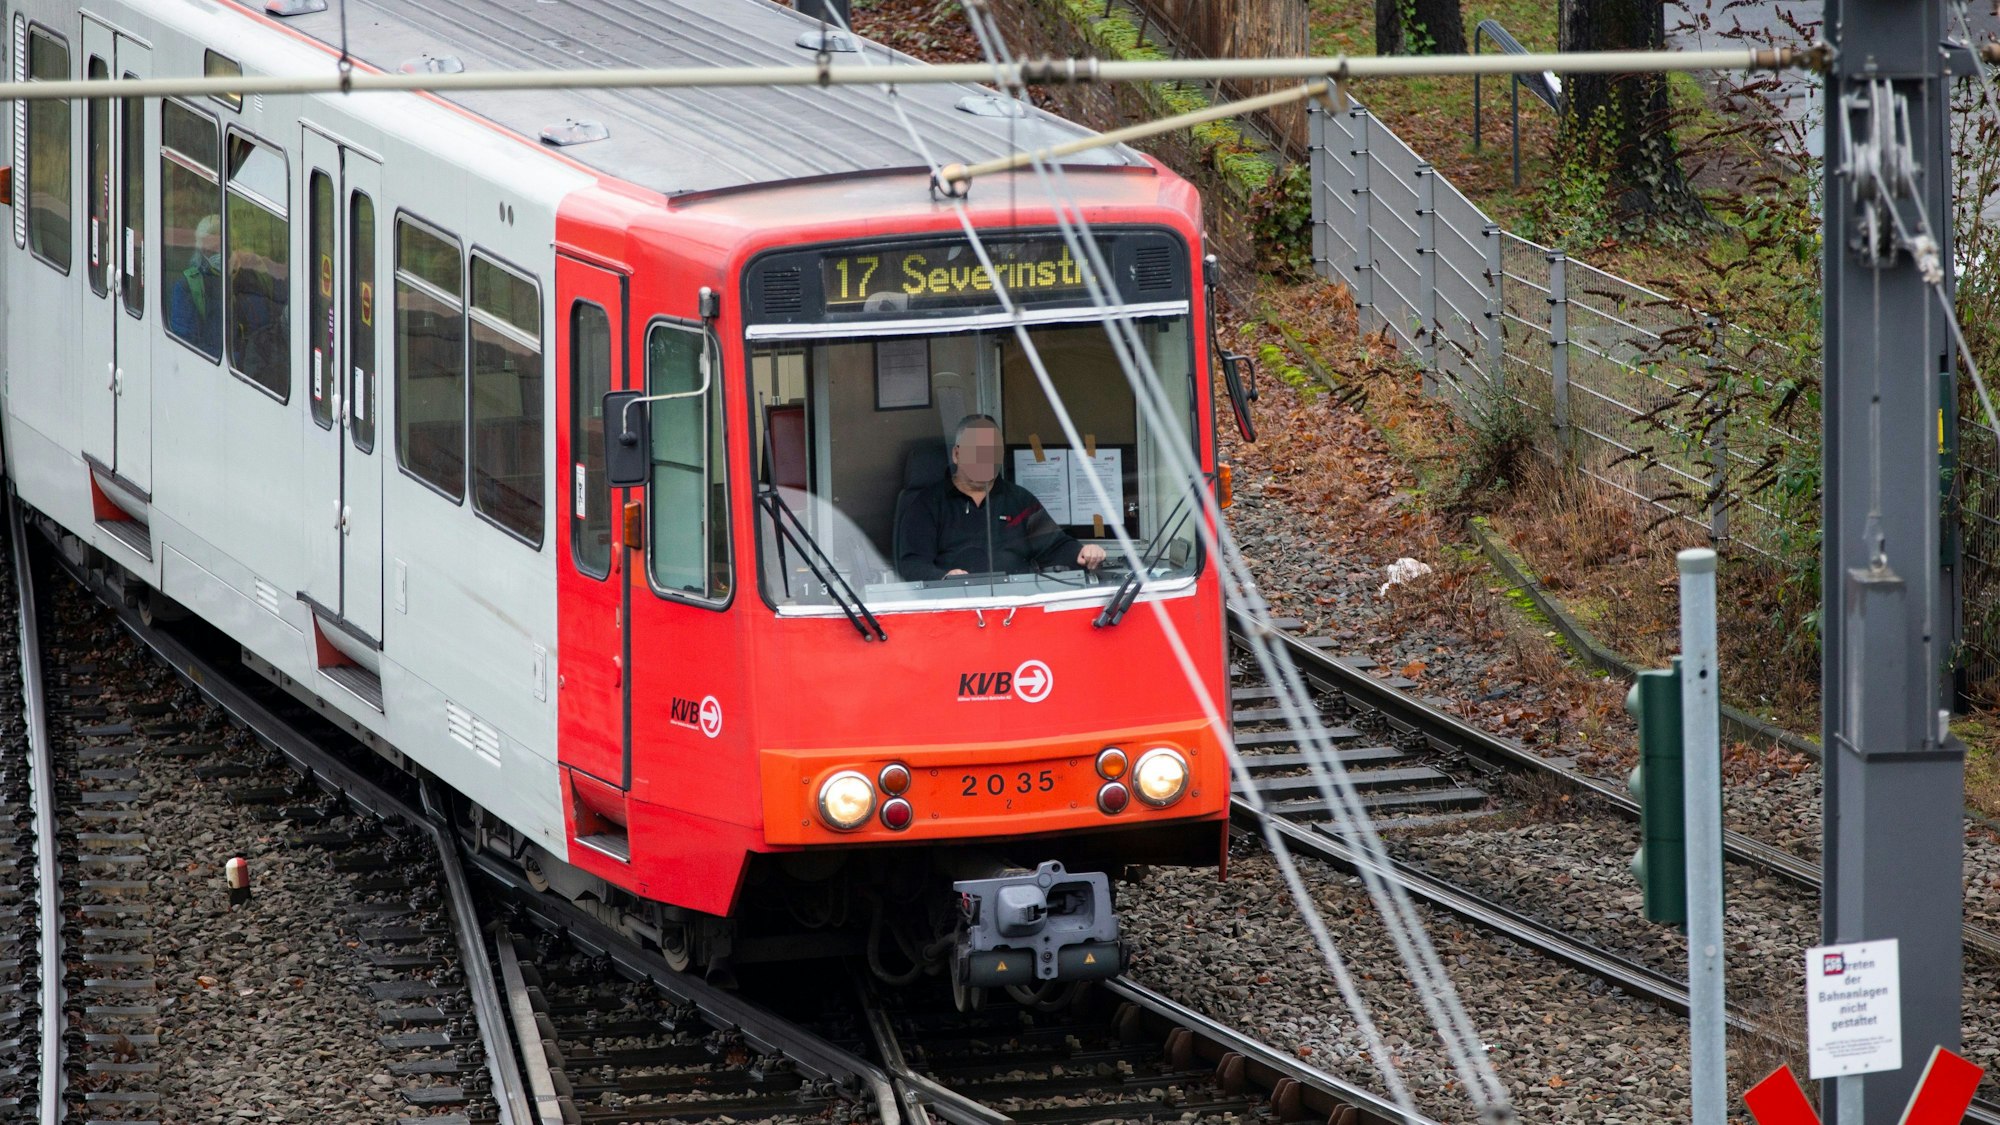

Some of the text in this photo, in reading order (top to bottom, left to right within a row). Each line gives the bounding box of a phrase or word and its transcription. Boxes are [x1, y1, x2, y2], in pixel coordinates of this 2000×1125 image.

[836, 256, 879, 299] 17
[958, 671, 1012, 696] KVB
[671, 697, 699, 724] KVB
[961, 770, 1054, 796] 2035
[1845, 975, 1861, 985] der
[1818, 986, 1888, 1003] Bahnanlagen
[1840, 1002, 1867, 1014] nicht
[1831, 1015, 1877, 1031] gestattet
